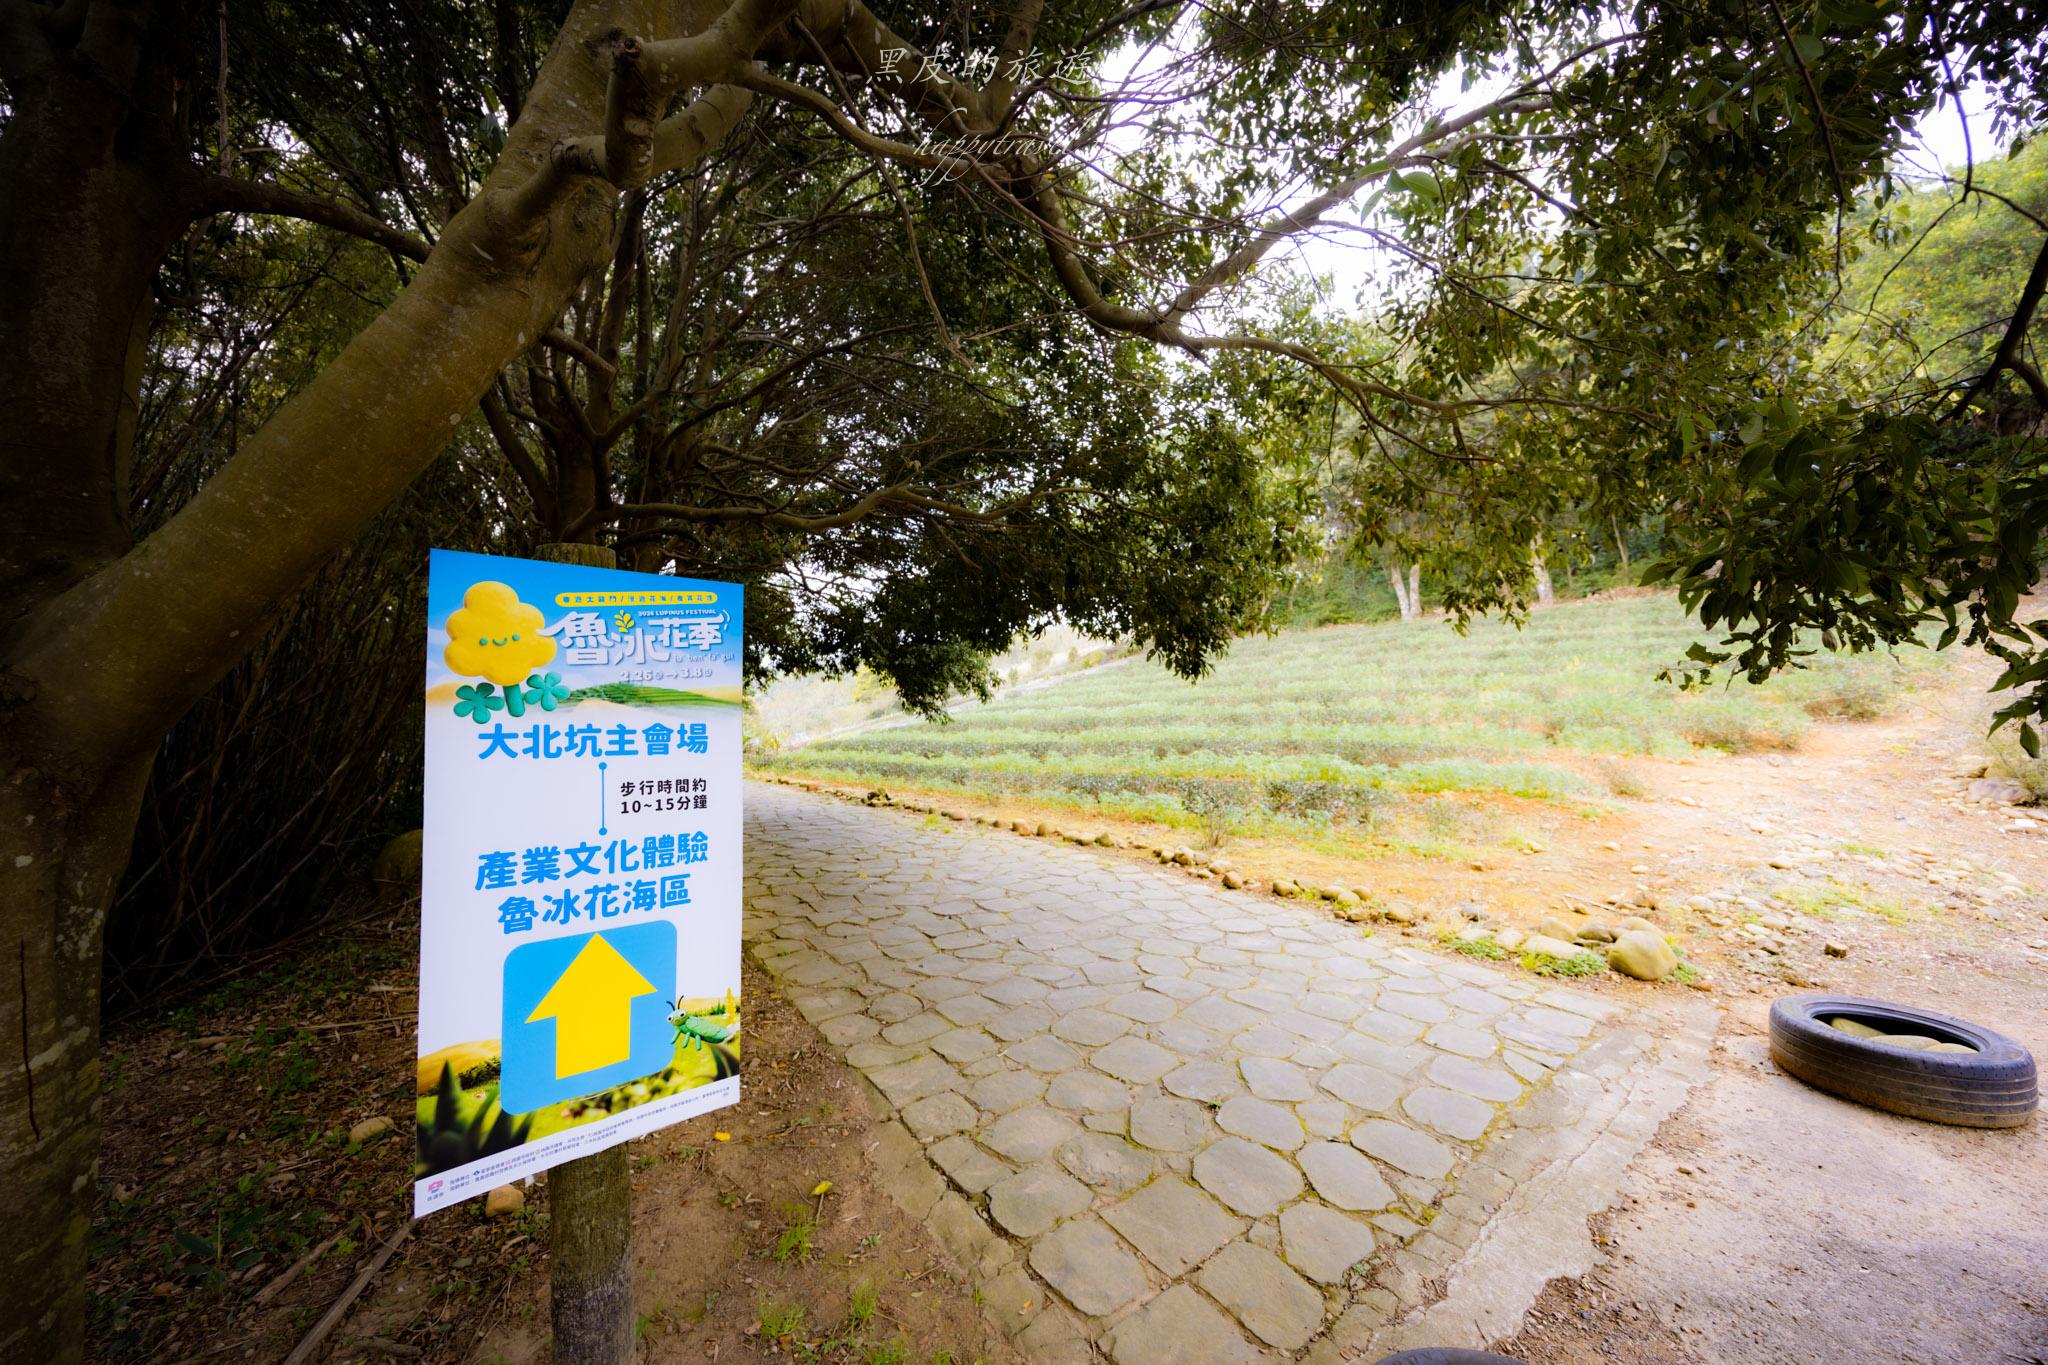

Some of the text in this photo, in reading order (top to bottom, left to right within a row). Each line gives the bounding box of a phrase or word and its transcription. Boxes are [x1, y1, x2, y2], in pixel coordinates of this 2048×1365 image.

[537, 610, 724, 665] 魯冰花季
[478, 723, 709, 760] 大北坑主會場
[620, 778, 707, 797] 步行時間約
[620, 795, 708, 814] 10~15分鐘
[474, 830, 709, 890] 產業文化體驗
[498, 873, 691, 935] 魯冰花海區
